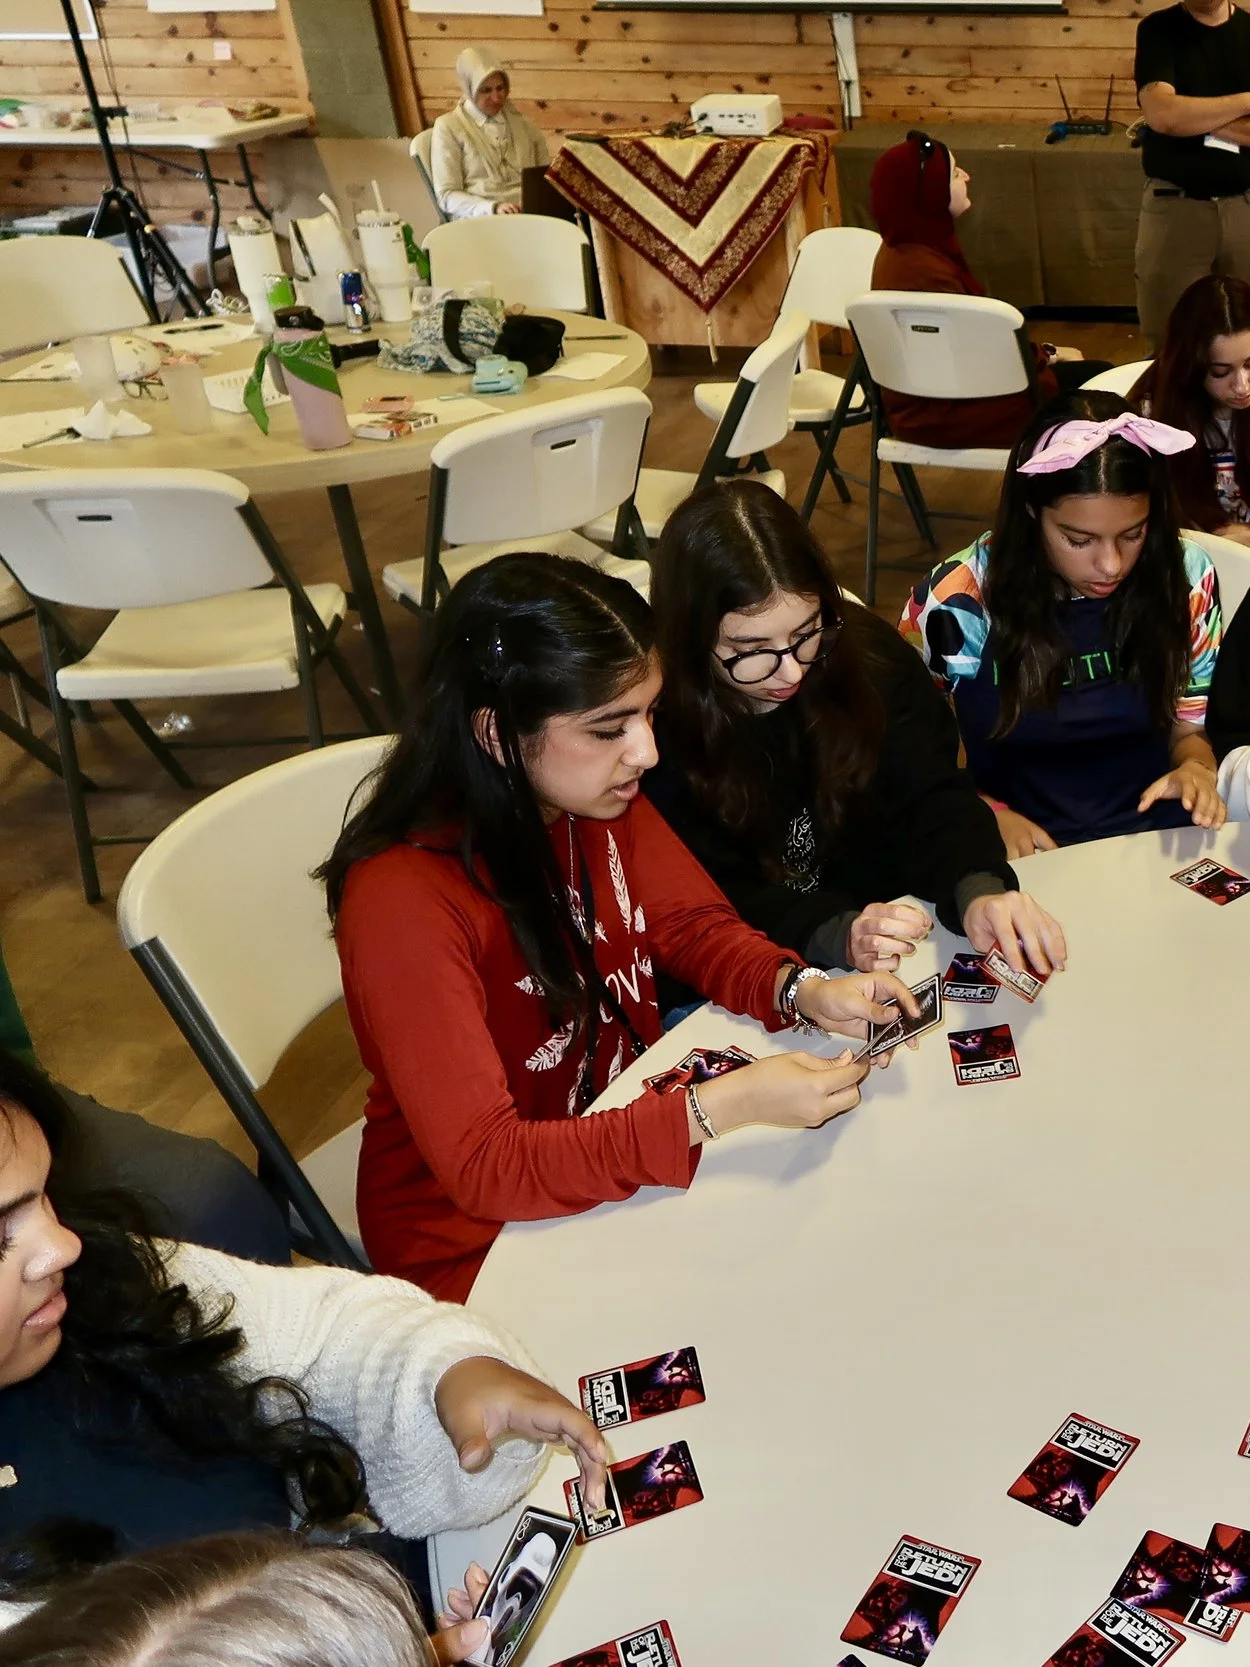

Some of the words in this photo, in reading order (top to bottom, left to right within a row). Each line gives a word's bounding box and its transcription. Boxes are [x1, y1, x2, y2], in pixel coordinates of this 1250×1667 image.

[592, 1378, 605, 1427] RETURN
[599, 1374, 625, 1415] JEDI
[1066, 1422, 1127, 1451] RETURN
[1067, 1434, 1124, 1461] JEDI
[900, 1547, 968, 1574] RETURN
[938, 1550, 965, 1563] WARS
[901, 1557, 964, 1587] JEDI
[1110, 1602, 1171, 1648] RETURN
[1128, 1604, 1147, 1620] STAR
[1146, 1613, 1171, 1634] WARS
[1105, 1618, 1166, 1660] JEDI
